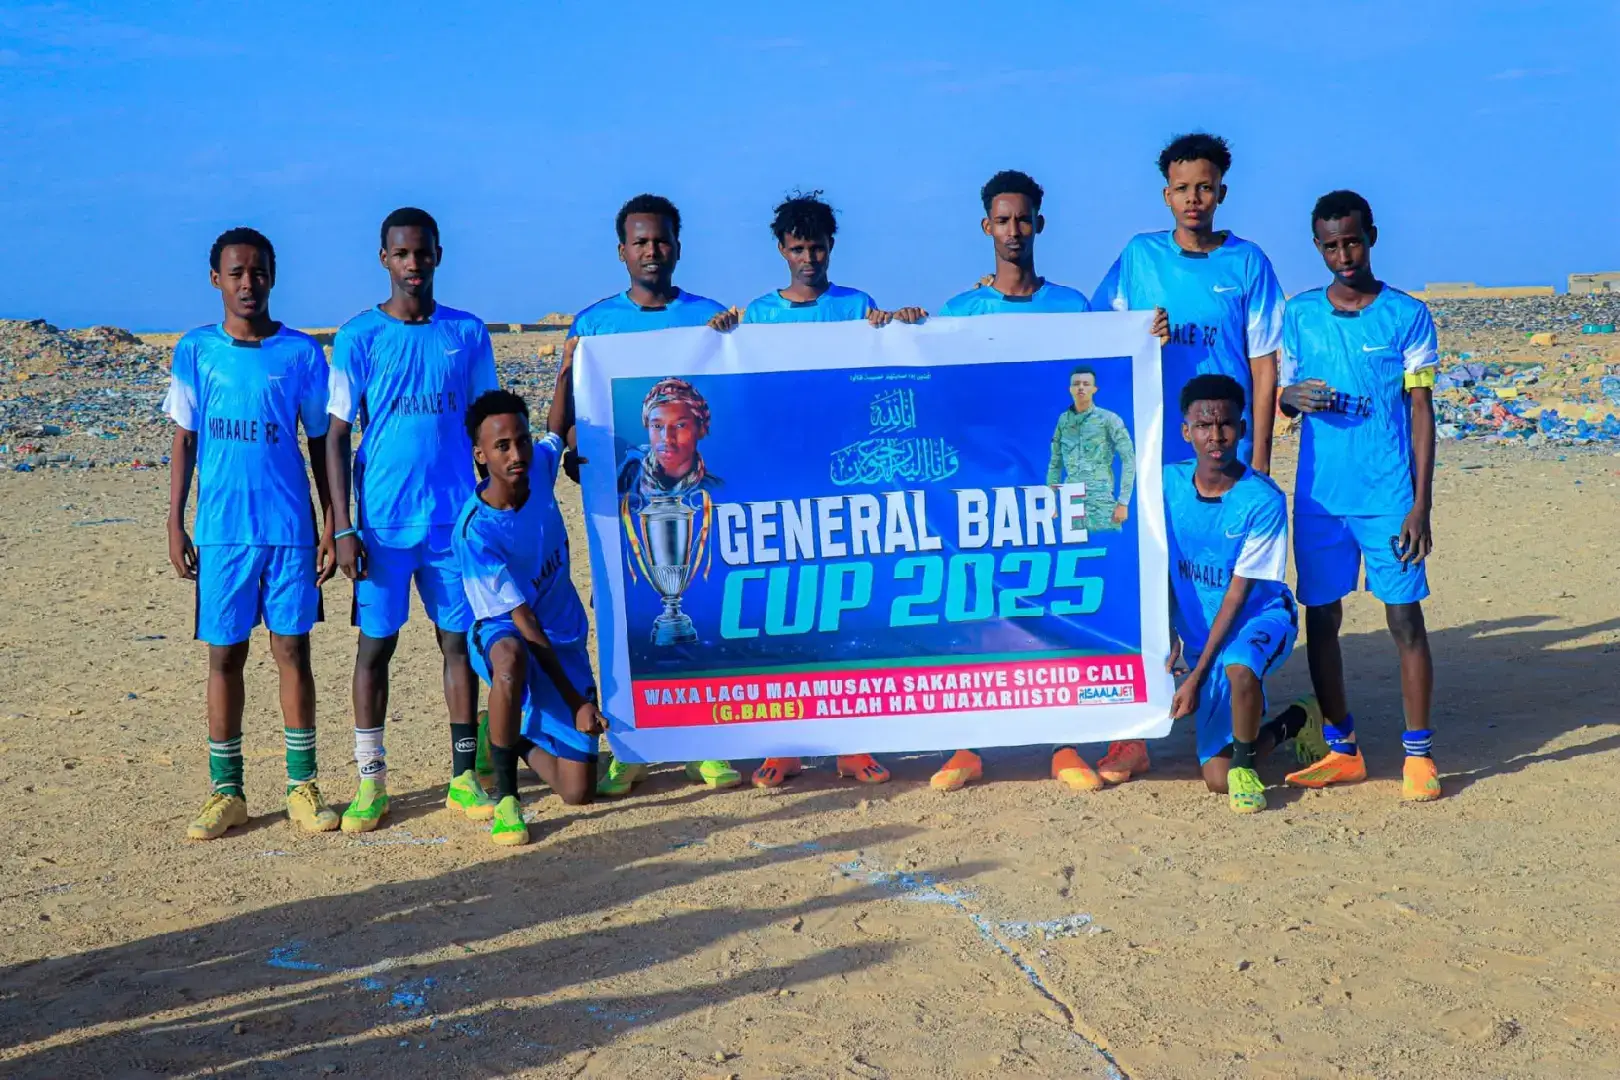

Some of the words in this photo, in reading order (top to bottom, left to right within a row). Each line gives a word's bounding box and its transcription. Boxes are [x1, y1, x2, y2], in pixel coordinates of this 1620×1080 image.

[209, 417, 257, 442] MIRAALE
[265, 421, 279, 444] FC
[712, 489, 942, 566] GENERAL
[951, 482, 1088, 549] BARE
[720, 561, 873, 640] CUP
[889, 547, 1107, 627] 2025
[644, 687, 700, 706] WAXA
[706, 684, 759, 702] LAGU
[766, 677, 897, 699] MAAMUSAYA
[903, 670, 1007, 693] SAKARIYE
[1013, 666, 1080, 686] SICIID
[1087, 663, 1134, 682] CALI
[712, 698, 804, 724] (G.BARE)
[816, 697, 882, 716] ALLAH
[889, 694, 917, 712] HA
[923, 693, 936, 710] U
[943, 686, 1071, 709] NAXARIISTO
